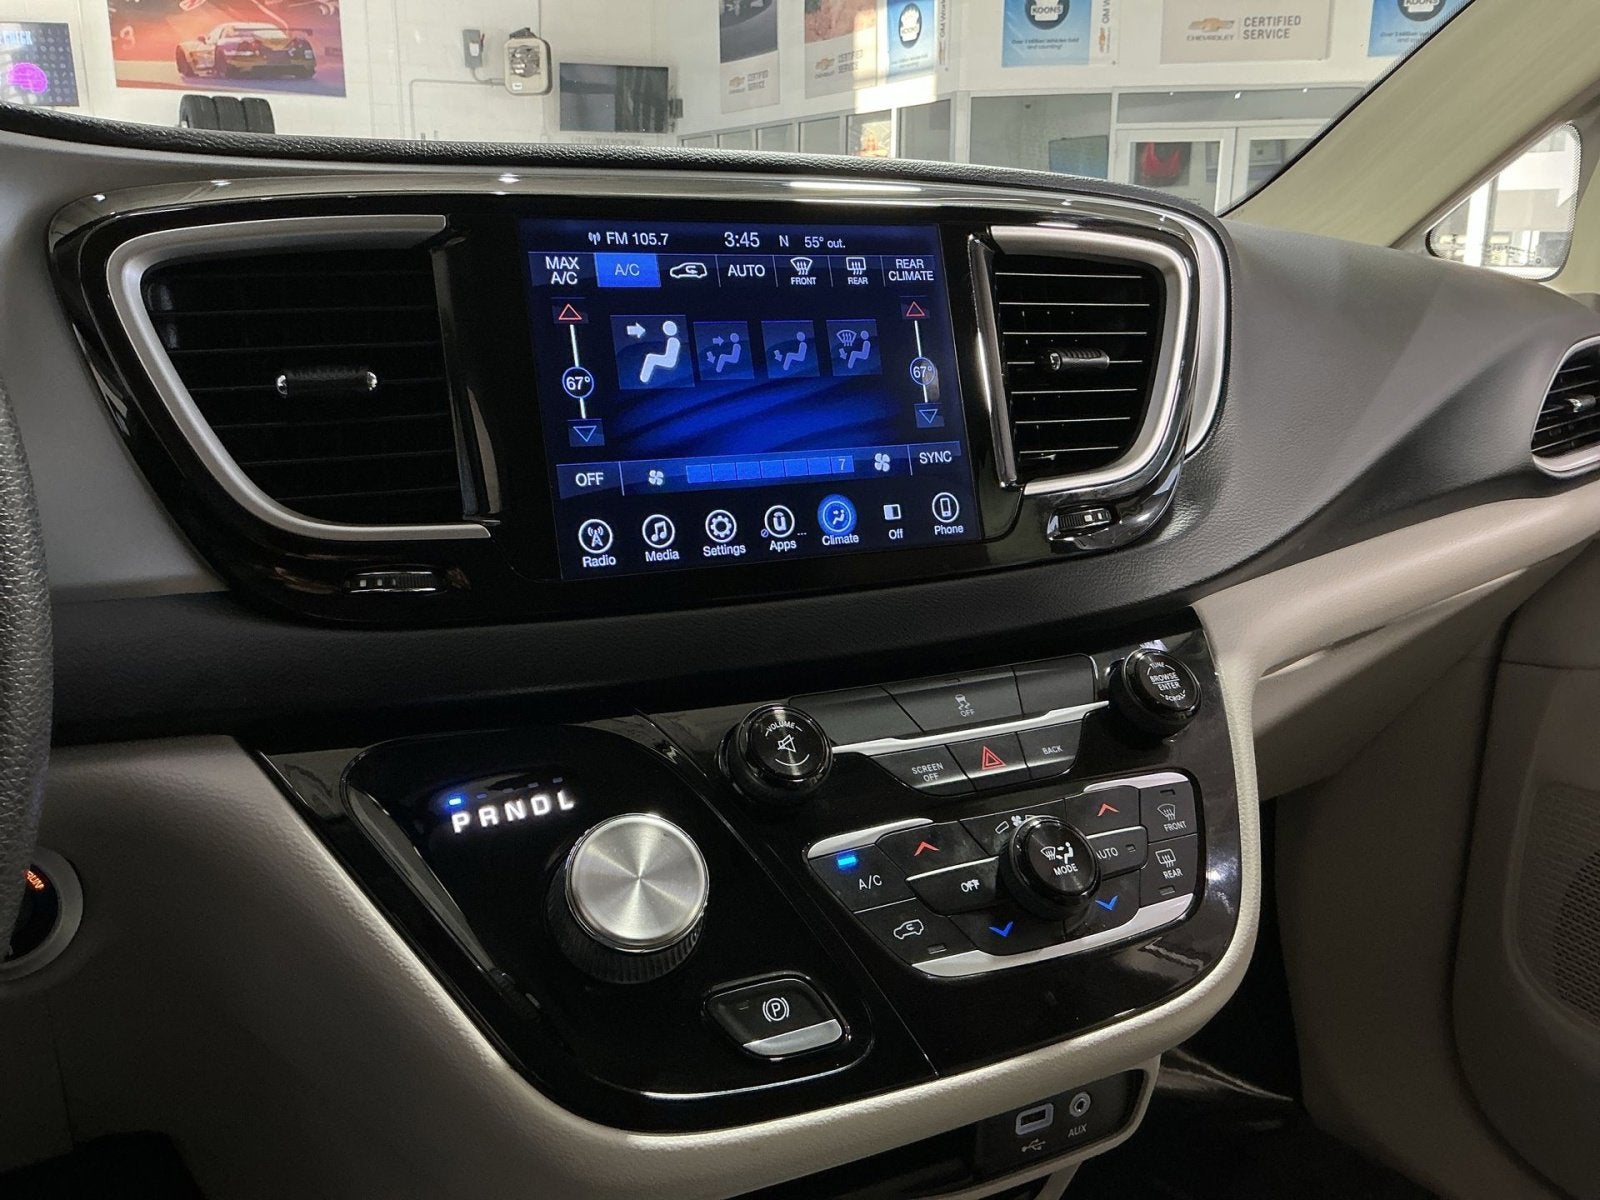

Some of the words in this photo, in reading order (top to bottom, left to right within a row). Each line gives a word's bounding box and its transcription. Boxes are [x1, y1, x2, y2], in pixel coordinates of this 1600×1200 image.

[1032, 6, 1062, 14] KOONS
[1243, 15, 1301, 27] CERTIFIED
[1243, 28, 1290, 40] SERVICE
[606, 232, 629, 245] FM
[632, 232, 669, 246] 105.7
[724, 231, 760, 248] 3:45
[779, 235, 789, 247] N
[827, 238, 846, 249] out.
[545, 256, 580, 270] MAX
[895, 258, 924, 269] REAR
[614, 263, 640, 276] A/C
[727, 264, 766, 277] AUTO
[888, 270, 934, 281] CLIMATE
[551, 271, 578, 285] A/C
[790, 277, 817, 285] FRONT
[847, 277, 869, 285] REAR
[919, 450, 953, 464] SYNC
[838, 458, 846, 471] 7
[575, 471, 604, 487] OFF
[888, 528, 904, 540] Off
[934, 523, 964, 536] Phone
[821, 533, 860, 546] Climate
[703, 543, 746, 557] Settings
[769, 540, 797, 552] Apps
[582, 555, 616, 568] Radio
[645, 549, 680, 562] Media
[1149, 661, 1165, 669] TUNE
[1149, 671, 1179, 683] BROWSE
[1157, 681, 1181, 691] ENTER
[960, 708, 976, 718] OFF
[766, 721, 796, 732] VOLUME
[1041, 745, 1064, 755] BACK
[911, 762, 944, 775] SCREEN
[923, 773, 940, 783] OFF
[1163, 820, 1188, 832] FRONT
[1053, 863, 1079, 876] MODE
[1163, 868, 1184, 880] REAR
[26, 870, 45, 890] RUN
[858, 874, 882, 890] A/C
[960, 879, 980, 892] OFF
[1067, 1123, 1088, 1138] AUX
